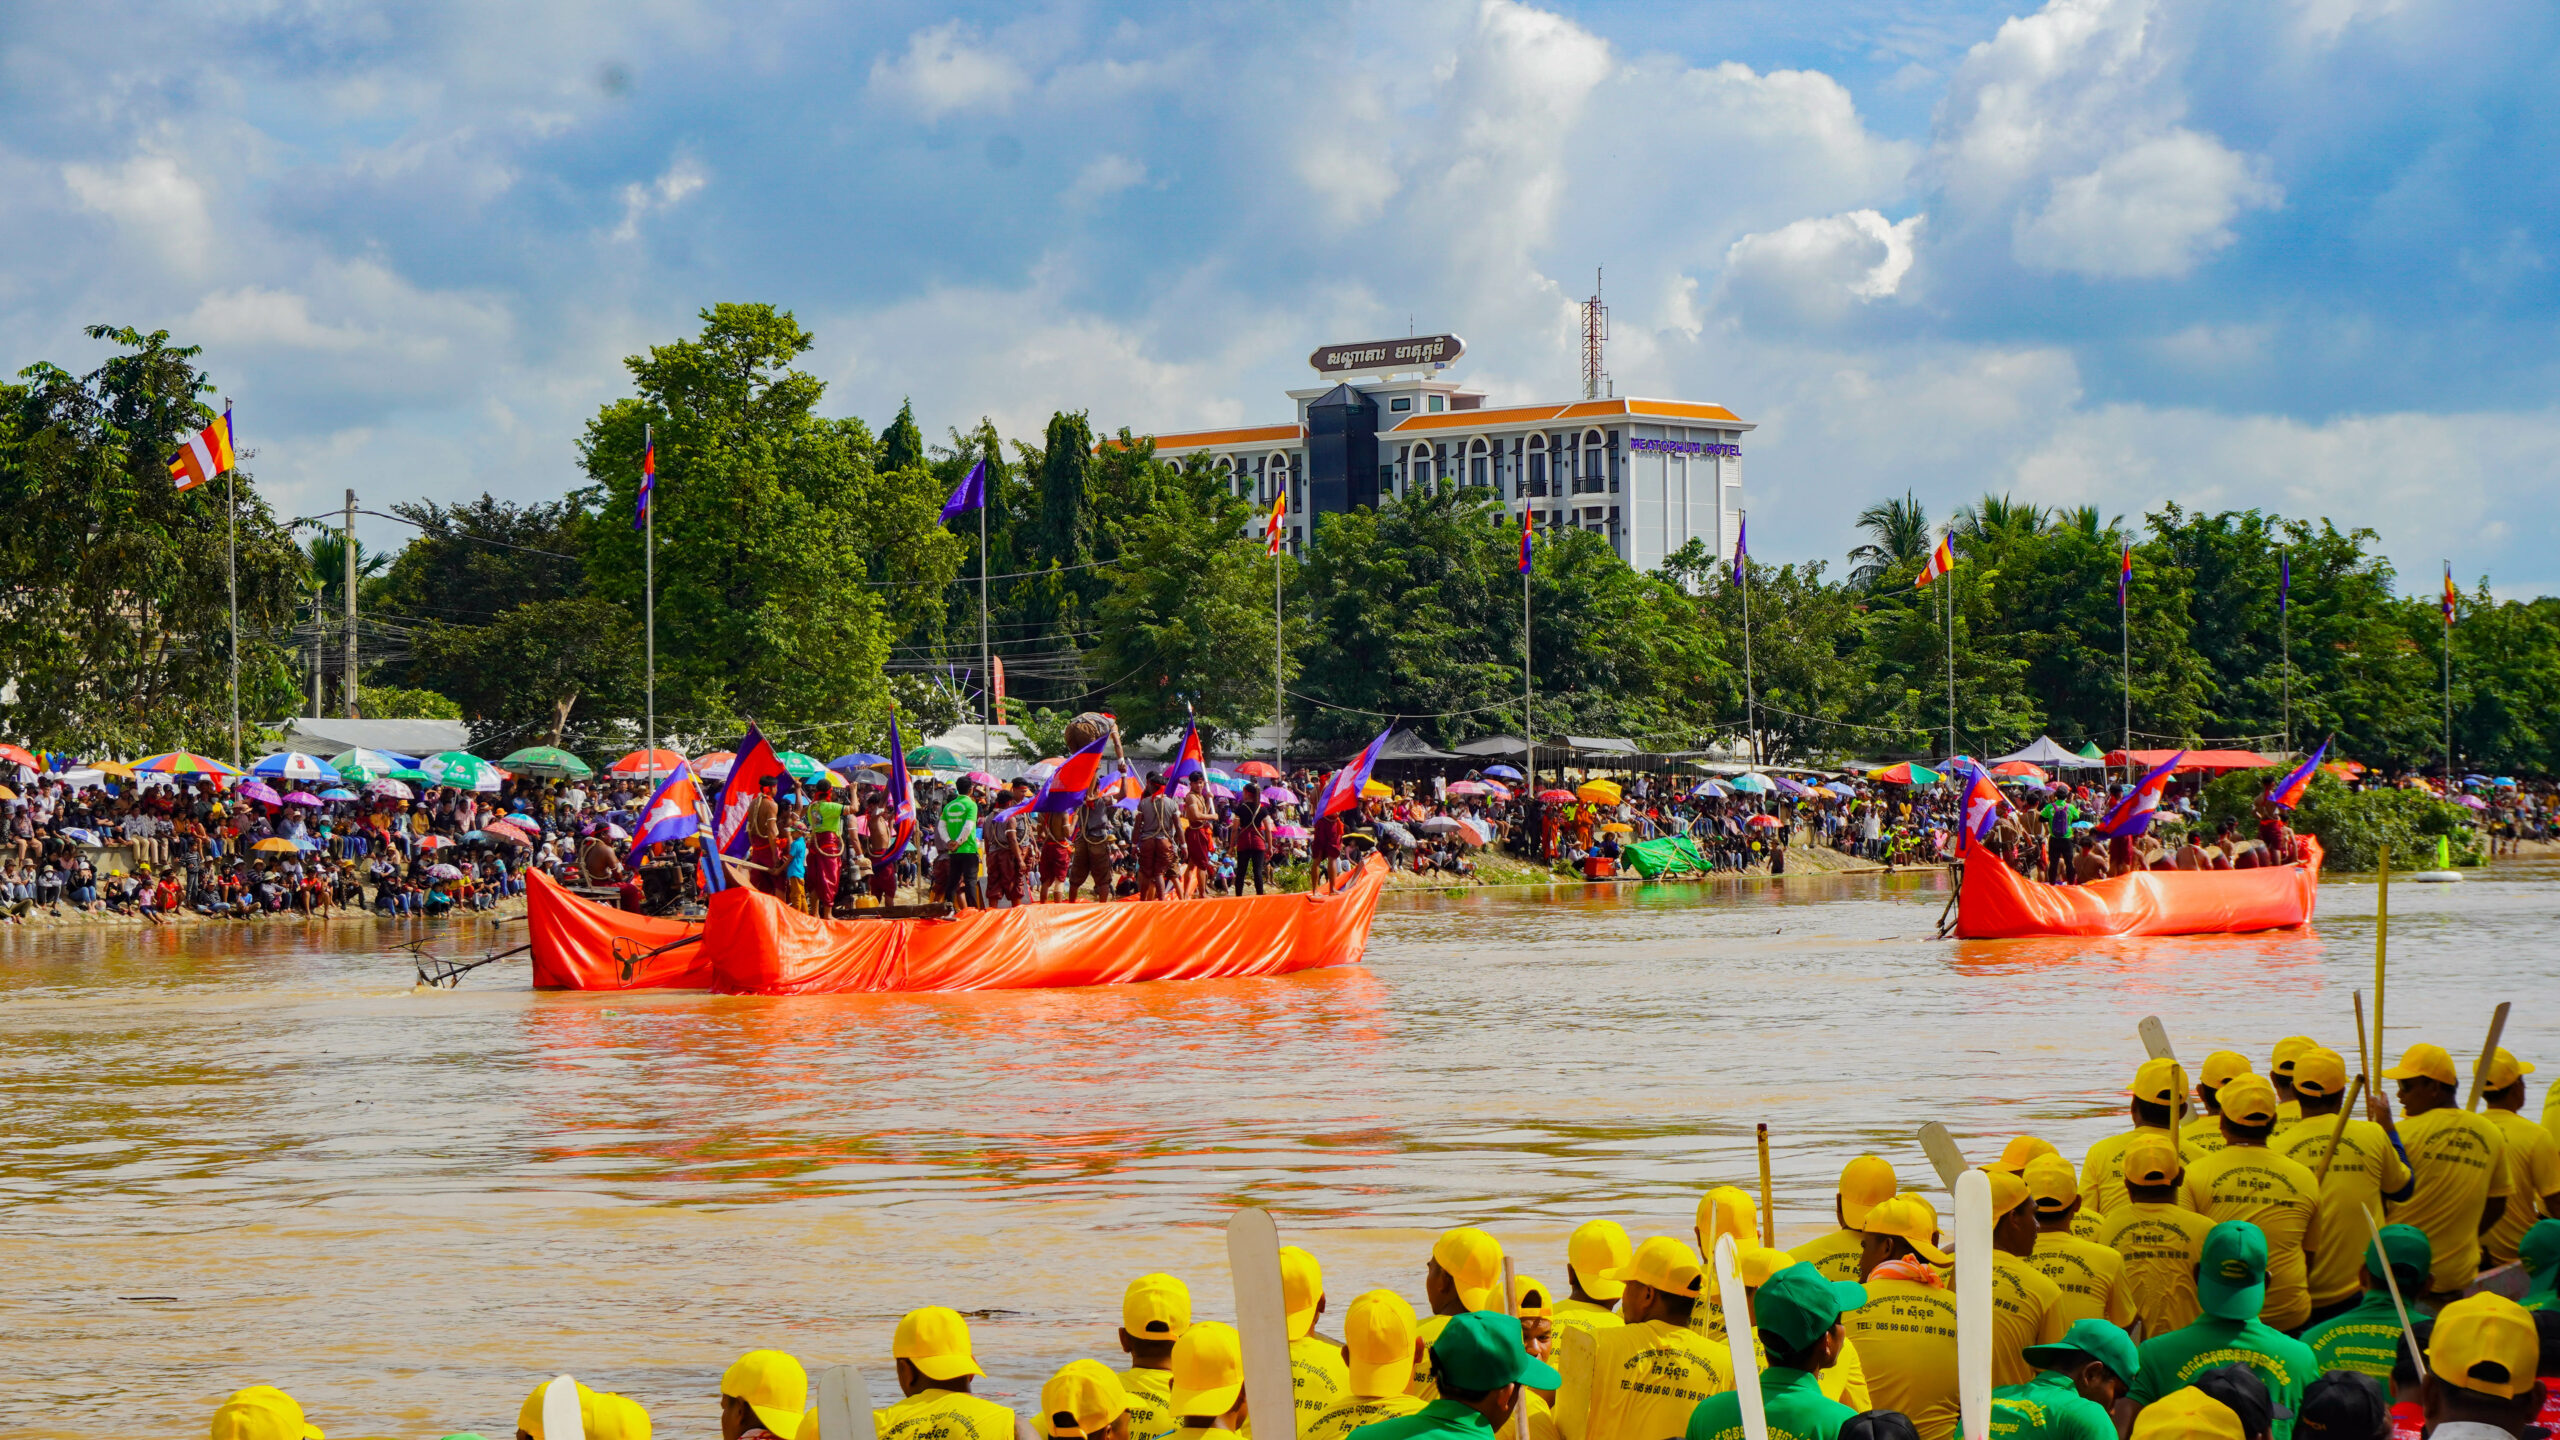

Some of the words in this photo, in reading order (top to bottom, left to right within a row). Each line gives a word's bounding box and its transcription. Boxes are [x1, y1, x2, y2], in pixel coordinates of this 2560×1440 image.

[1705, 442, 1742, 457] HOTEL
[1856, 1322, 1872, 1330] TEL:
[1876, 1322, 1888, 1330] 085
[1890, 1322, 1899, 1331] 99
[1900, 1323, 1909, 1332] 60
[1910, 1324, 1919, 1333] 60
[1924, 1325, 1936, 1334] 081
[1938, 1327, 1946, 1336] 99
[1947, 1328, 1956, 1338] 60
[1620, 1379, 1632, 1390] TEL:
[1633, 1382, 1645, 1393] 085
[1645, 1383, 1653, 1394] 99
[1653, 1384, 1661, 1395] 60
[1661, 1385, 1670, 1396] 60
[1675, 1388, 1687, 1399] 081
[1688, 1390, 1697, 1400] 99
[1697, 1391, 1706, 1402] 60
[1304, 1399, 1313, 1409] 99
[1313, 1400, 1322, 1411] 60
